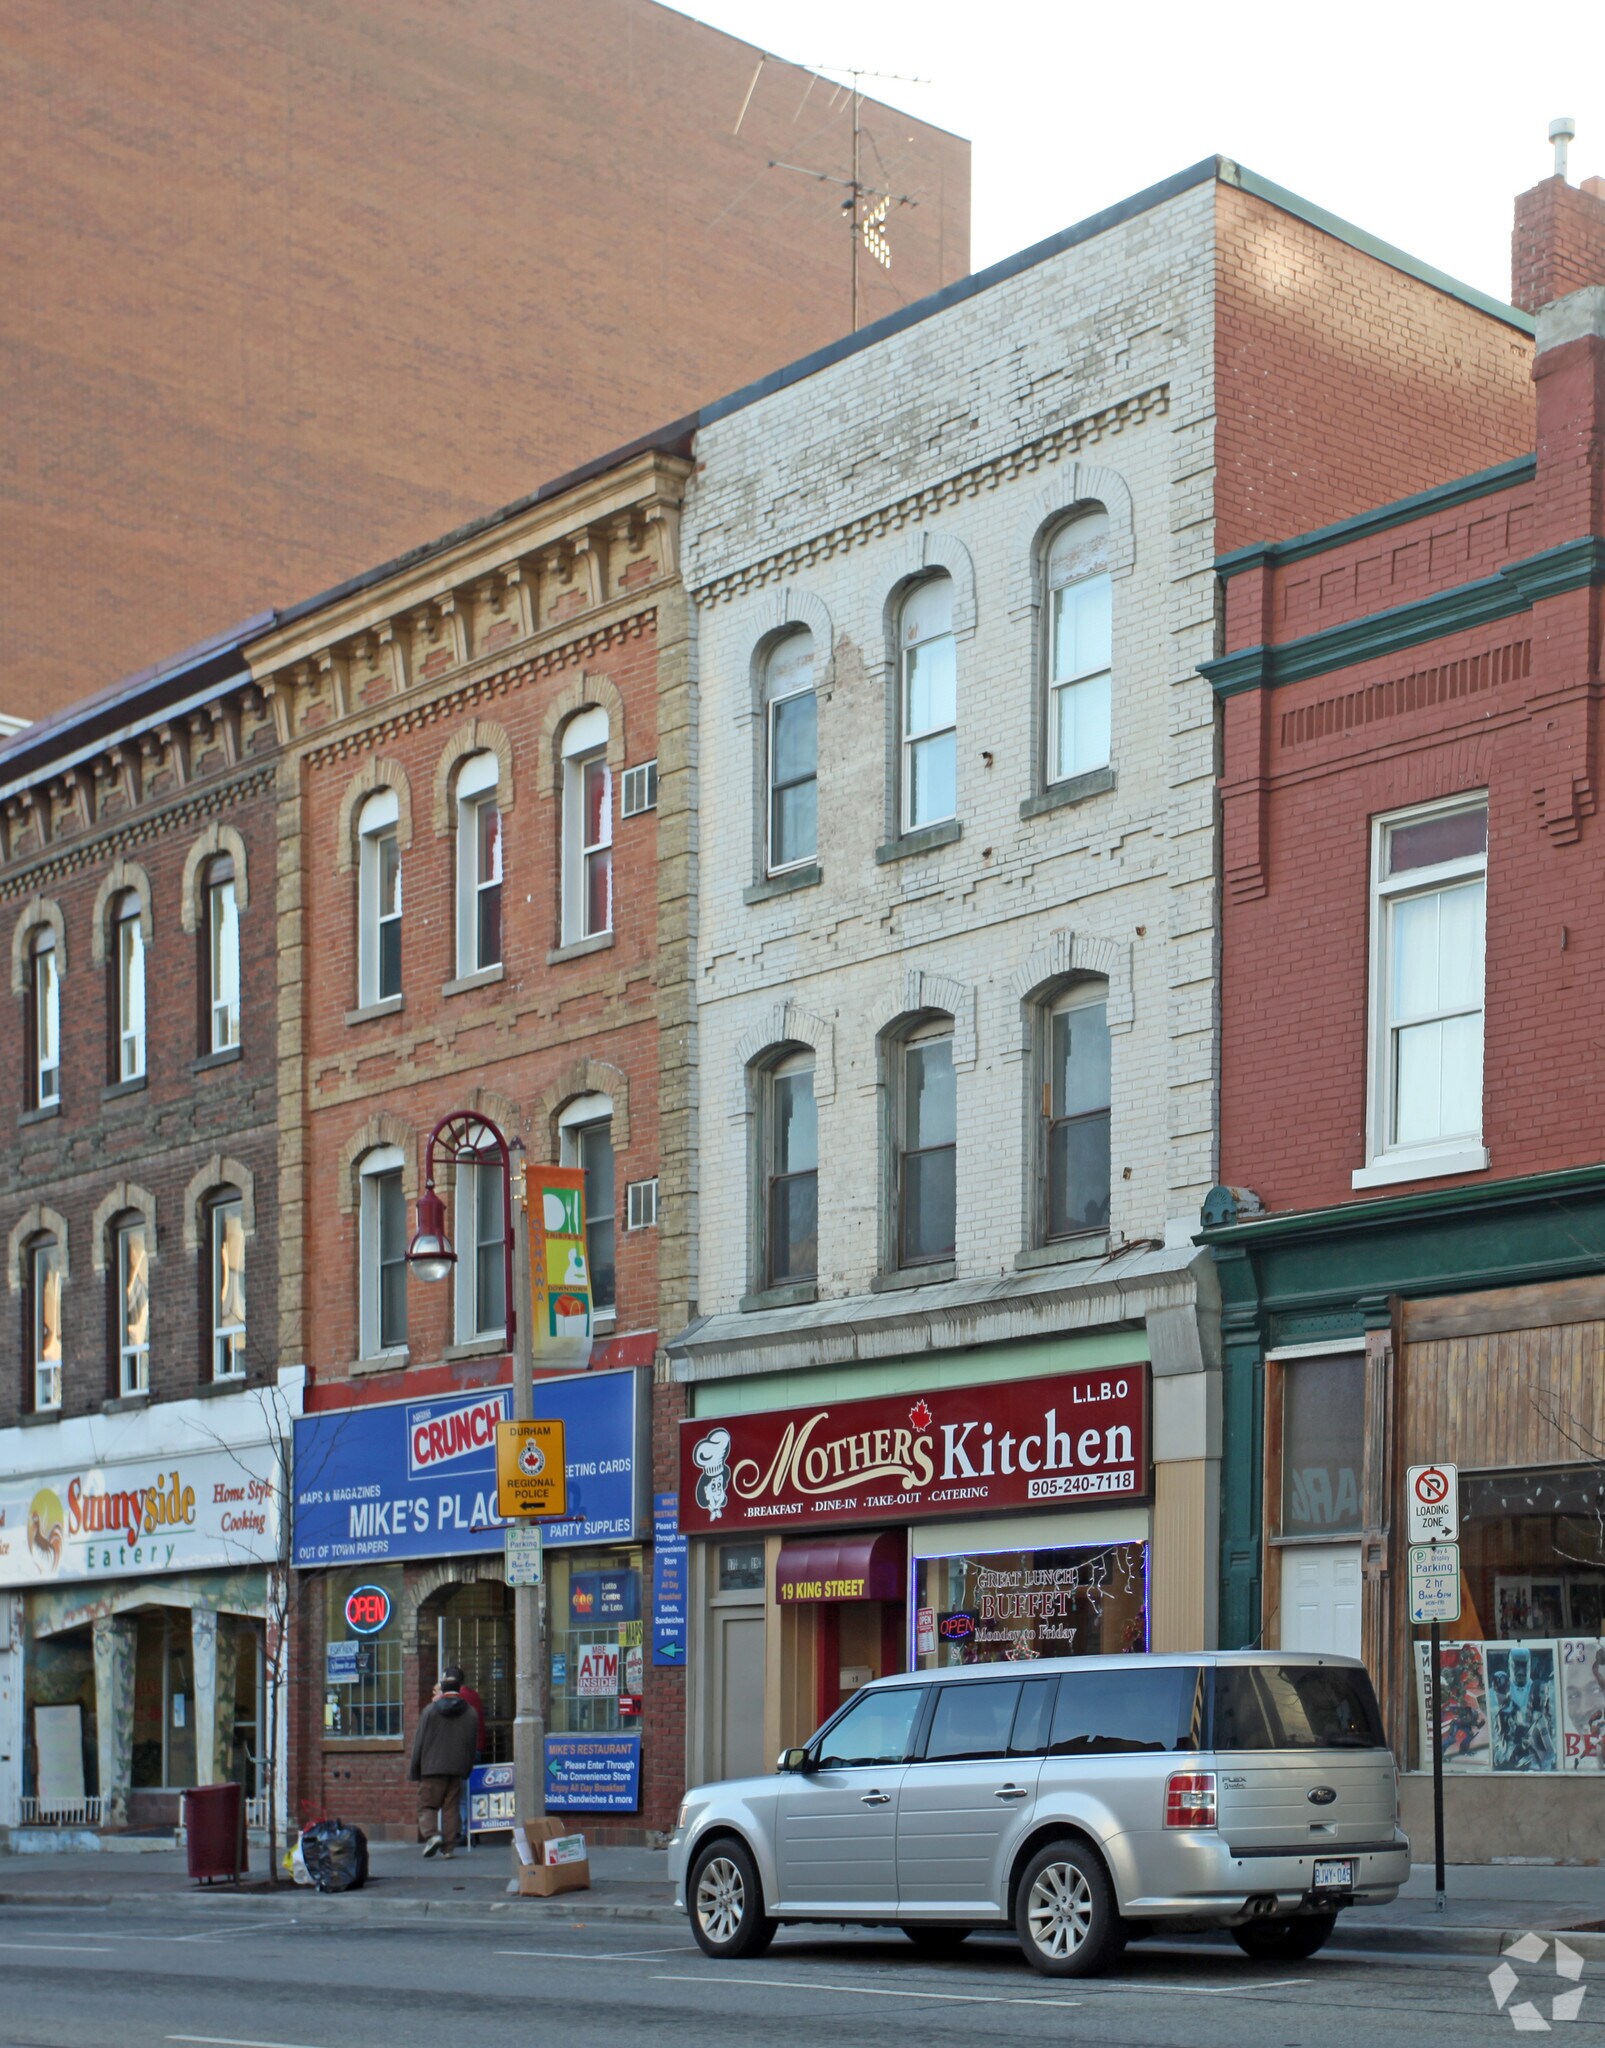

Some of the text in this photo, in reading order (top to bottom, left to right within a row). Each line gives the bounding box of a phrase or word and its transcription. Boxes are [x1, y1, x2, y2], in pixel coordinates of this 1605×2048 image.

[1073, 1379, 1128, 1404] L.L.B.O
[413, 1400, 500, 1465] CRUNCH
[510, 1427, 551, 1436] DURHAM
[939, 1408, 1135, 1480] Kitchen
[599, 1457, 631, 1474] CARDS
[213, 1477, 273, 1504] Home Style
[507, 1479, 556, 1488] REGIONAL
[1031, 1472, 1132, 1497] 905-240-7118
[300, 1484, 381, 1505] MAPS & MAGAZINES
[515, 1489, 549, 1499] POLICE
[68, 1471, 196, 1547] Sunnyside
[350, 1490, 515, 1538] MIKE'S PLAC
[1416, 1505, 1449, 1517] LOADING
[221, 1512, 265, 1534] Cooking
[550, 1523, 581, 1538] PARTY
[584, 1518, 631, 1535] SUPPLIES
[1422, 1517, 1444, 1528] ZONE
[88, 1543, 175, 1568] Eatery
[300, 1540, 389, 1559] OUT OF TOWN PAPERS
[1416, 1563, 1453, 1574] Parking
[601, 1582, 618, 1590] Lotto
[978, 1569, 1076, 1588] GREAT LUNCH
[1425, 1578, 1444, 1588] 2 hr
[782, 1579, 865, 1600] 19 KING STREET
[348, 1595, 386, 1623] OPEN
[981, 1591, 1072, 1619] BUFFET
[919, 1615, 932, 1626] OPEN
[940, 1618, 975, 1635] OPEN
[975, 1624, 1077, 1644] Monday to Friday
[1564, 1642, 1586, 1664] 23
[580, 1654, 618, 1677] ATM
[580, 1678, 616, 1687] INSIDE
[549, 1744, 633, 1755] MIKE'S RESTAURANT
[1565, 1733, 1605, 1757] BE
[564, 1760, 635, 1771] Please Enter Through
[557, 1772, 631, 1781] The Convenience Store
[580, 1783, 592, 1793] Day
[594, 1783, 626, 1792] Breakfast
[568, 1794, 607, 1804] Sandwiches
[615, 1796, 633, 1804] more
[482, 1820, 510, 1829] Million
